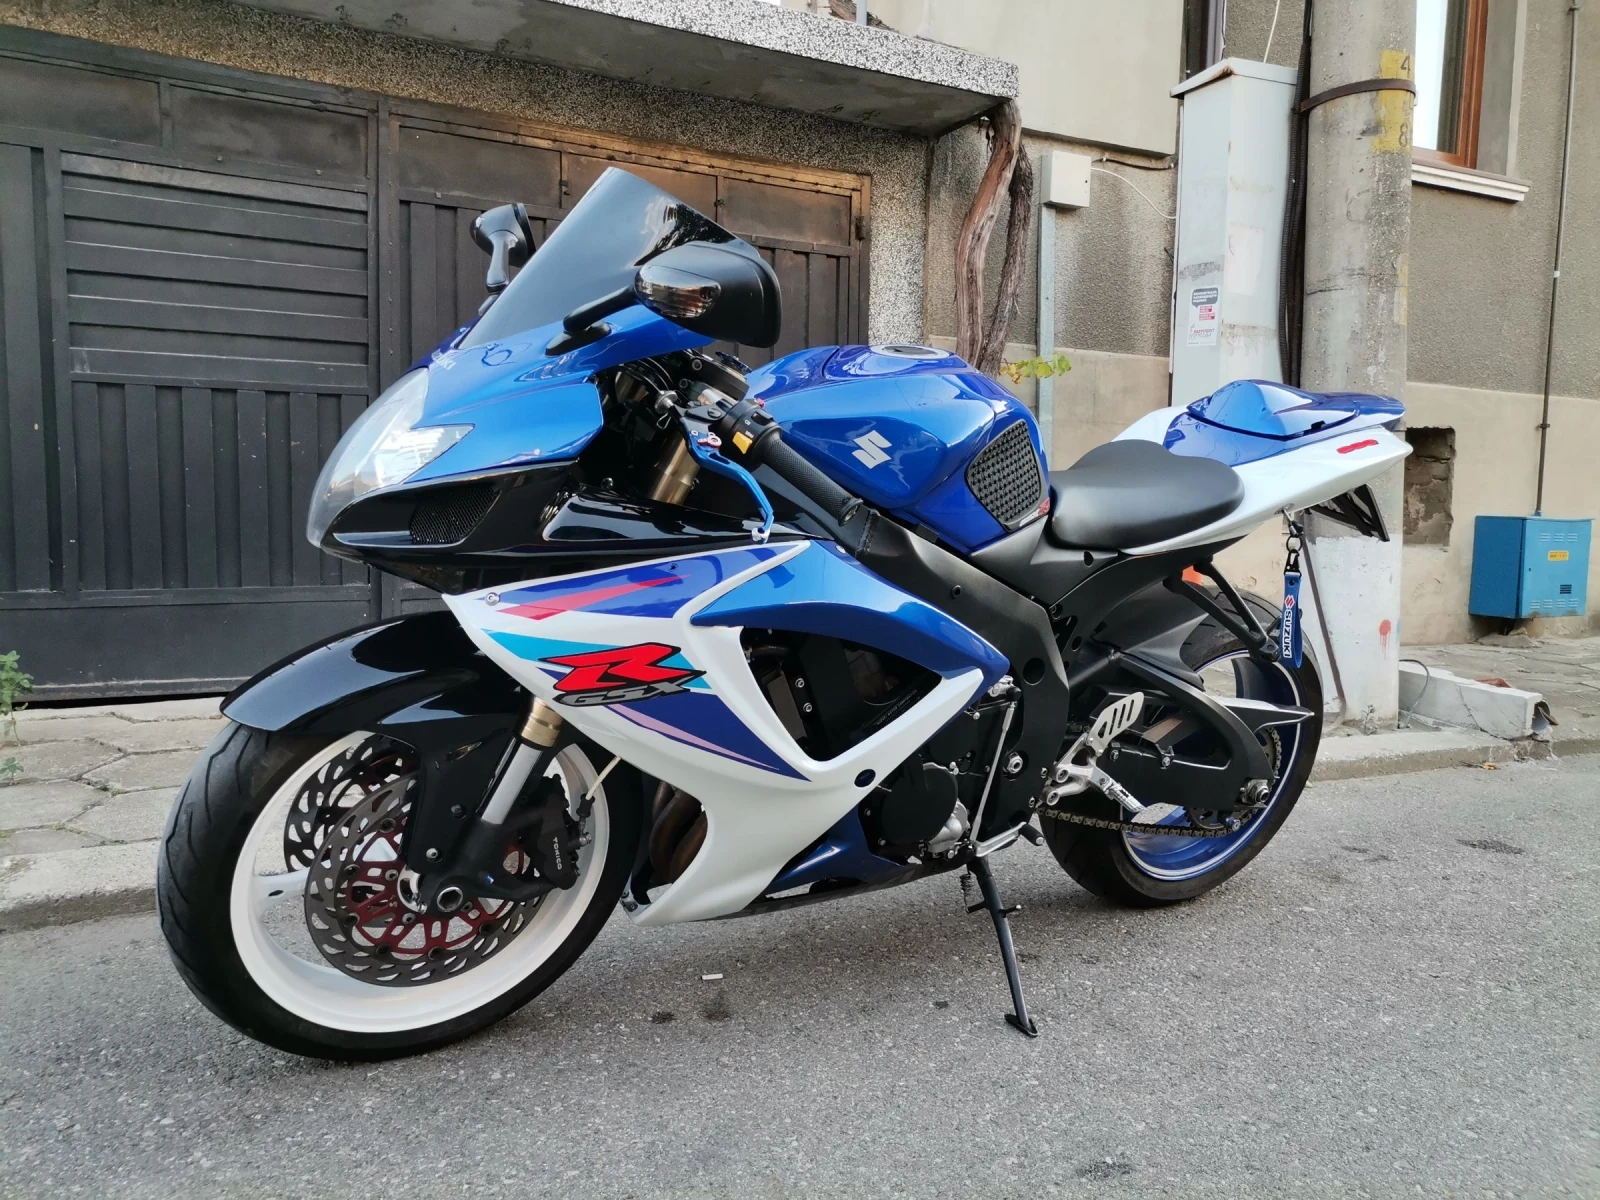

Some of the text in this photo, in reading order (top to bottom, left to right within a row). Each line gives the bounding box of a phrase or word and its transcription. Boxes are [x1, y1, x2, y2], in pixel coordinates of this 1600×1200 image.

[1400, 54, 1411, 79] 4
[1398, 123, 1408, 148] 8
[1283, 609, 1292, 658] SUZUKI
[541, 642, 698, 692] R
[556, 676, 697, 706] GSX
[552, 836, 563, 870] TOKICO
